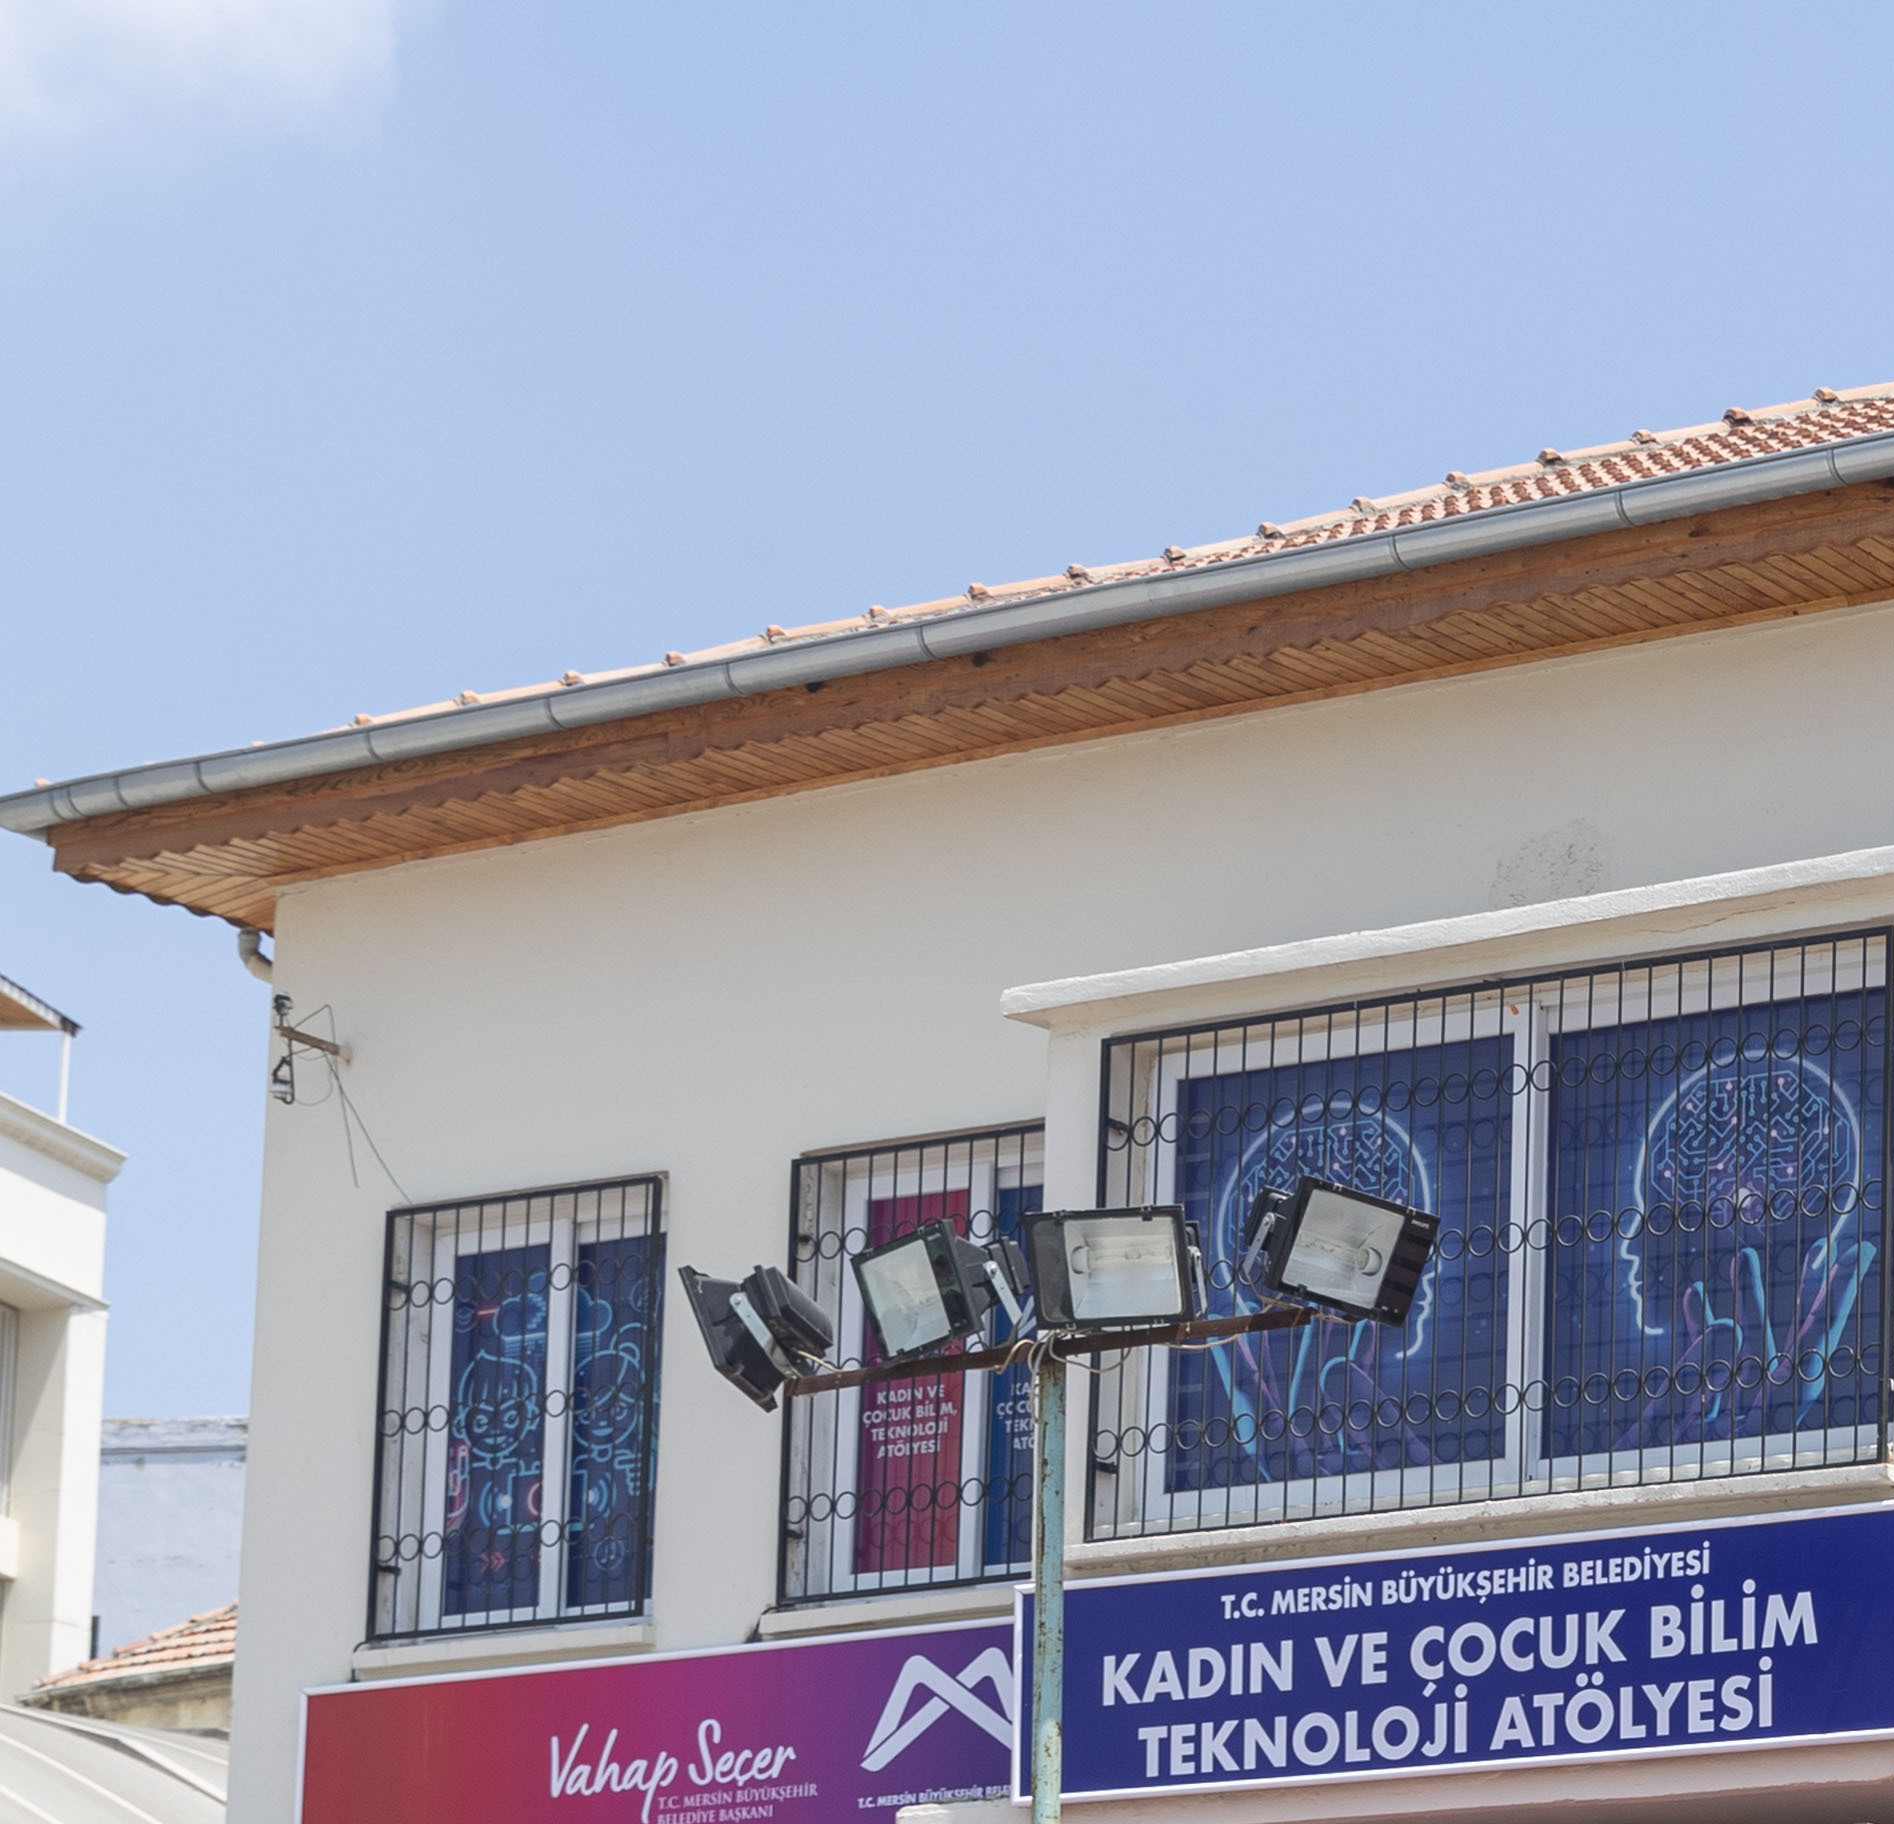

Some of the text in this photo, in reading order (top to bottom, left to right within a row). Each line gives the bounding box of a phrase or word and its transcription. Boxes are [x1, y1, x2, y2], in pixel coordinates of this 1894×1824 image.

[916, 1400, 958, 1418] BİLM,
[1221, 1541, 1710, 1620] T.C. MERSİN BÜYÜKŞEHİR BELEDİYESİ
[1101, 1578, 1819, 1708] KADIN VE ÇOCUK BİLİM
[1138, 1656, 1774, 1778] TEKNOLOJİ ATÖLYESİ
[550, 1719, 797, 1824] Vahap Seçer
[658, 1782, 818, 1810] T.C. MERSİN BÜYÜKŞEHİR
[719, 1804, 774, 1823] BAŞKANI
[857, 1797, 876, 1809] T.C.
[877, 1791, 917, 1808] MERSİN
